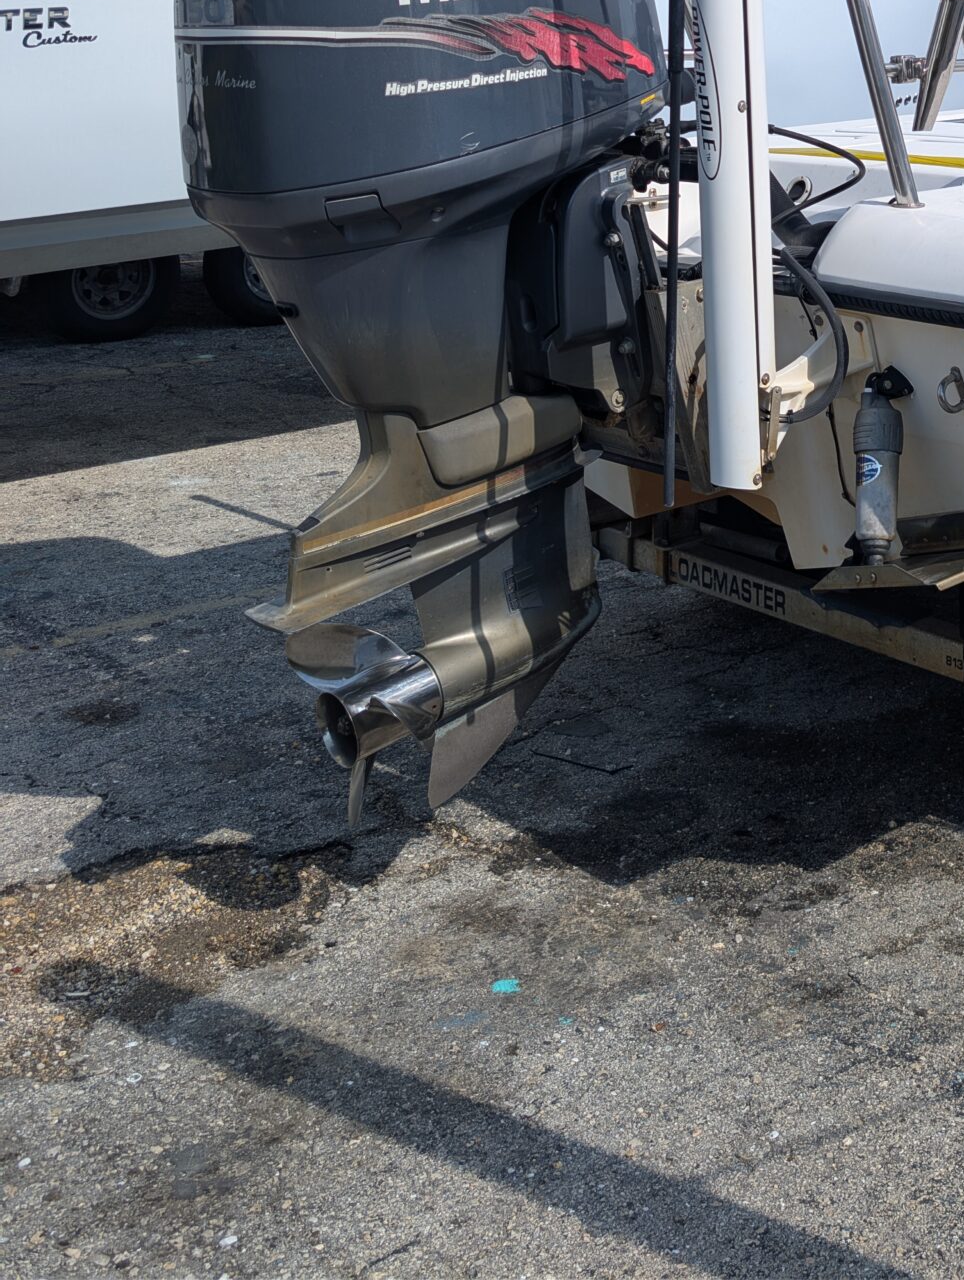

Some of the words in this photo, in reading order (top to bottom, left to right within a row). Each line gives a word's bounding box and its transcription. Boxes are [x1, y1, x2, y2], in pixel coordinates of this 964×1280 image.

[22, 30, 98, 49] Custom
[214, 70, 257, 89] Marine
[385, 81, 415, 97] High
[417, 79, 470, 94] Pressure
[471, 73, 505, 88] Direct
[505, 68, 548, 84] Injection
[669, 552, 786, 616] LOADMASTER
[946, 655, 963, 670] 813
